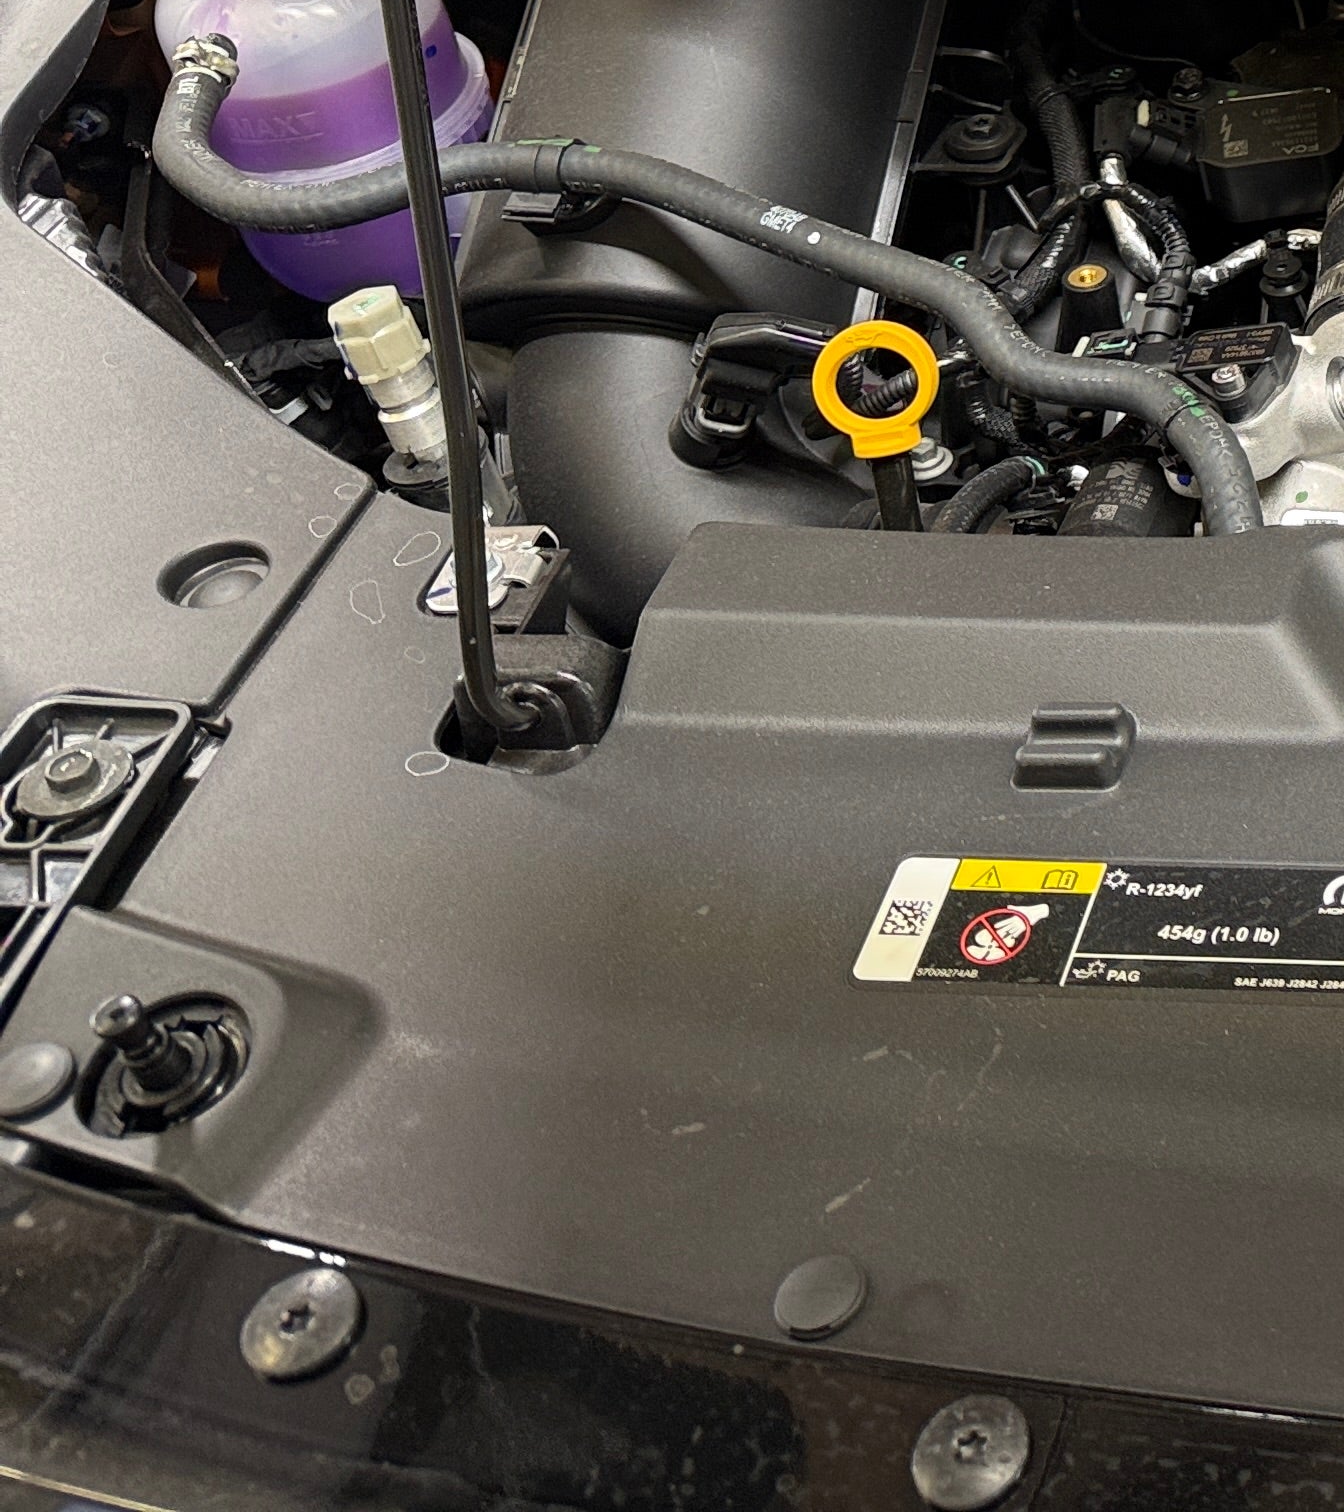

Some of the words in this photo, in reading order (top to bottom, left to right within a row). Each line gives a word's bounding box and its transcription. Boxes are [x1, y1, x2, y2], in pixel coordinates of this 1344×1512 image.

[1283, 143, 1320, 155] FCA
[1125, 882, 1204, 901] R-1234yf
[1157, 924, 1207, 945] 454g
[1210, 926, 1249, 945] (1.0
[1252, 927, 1280, 946] lb)
[1106, 970, 1141, 983] PAG
[1233, 976, 1257, 987] SAE
